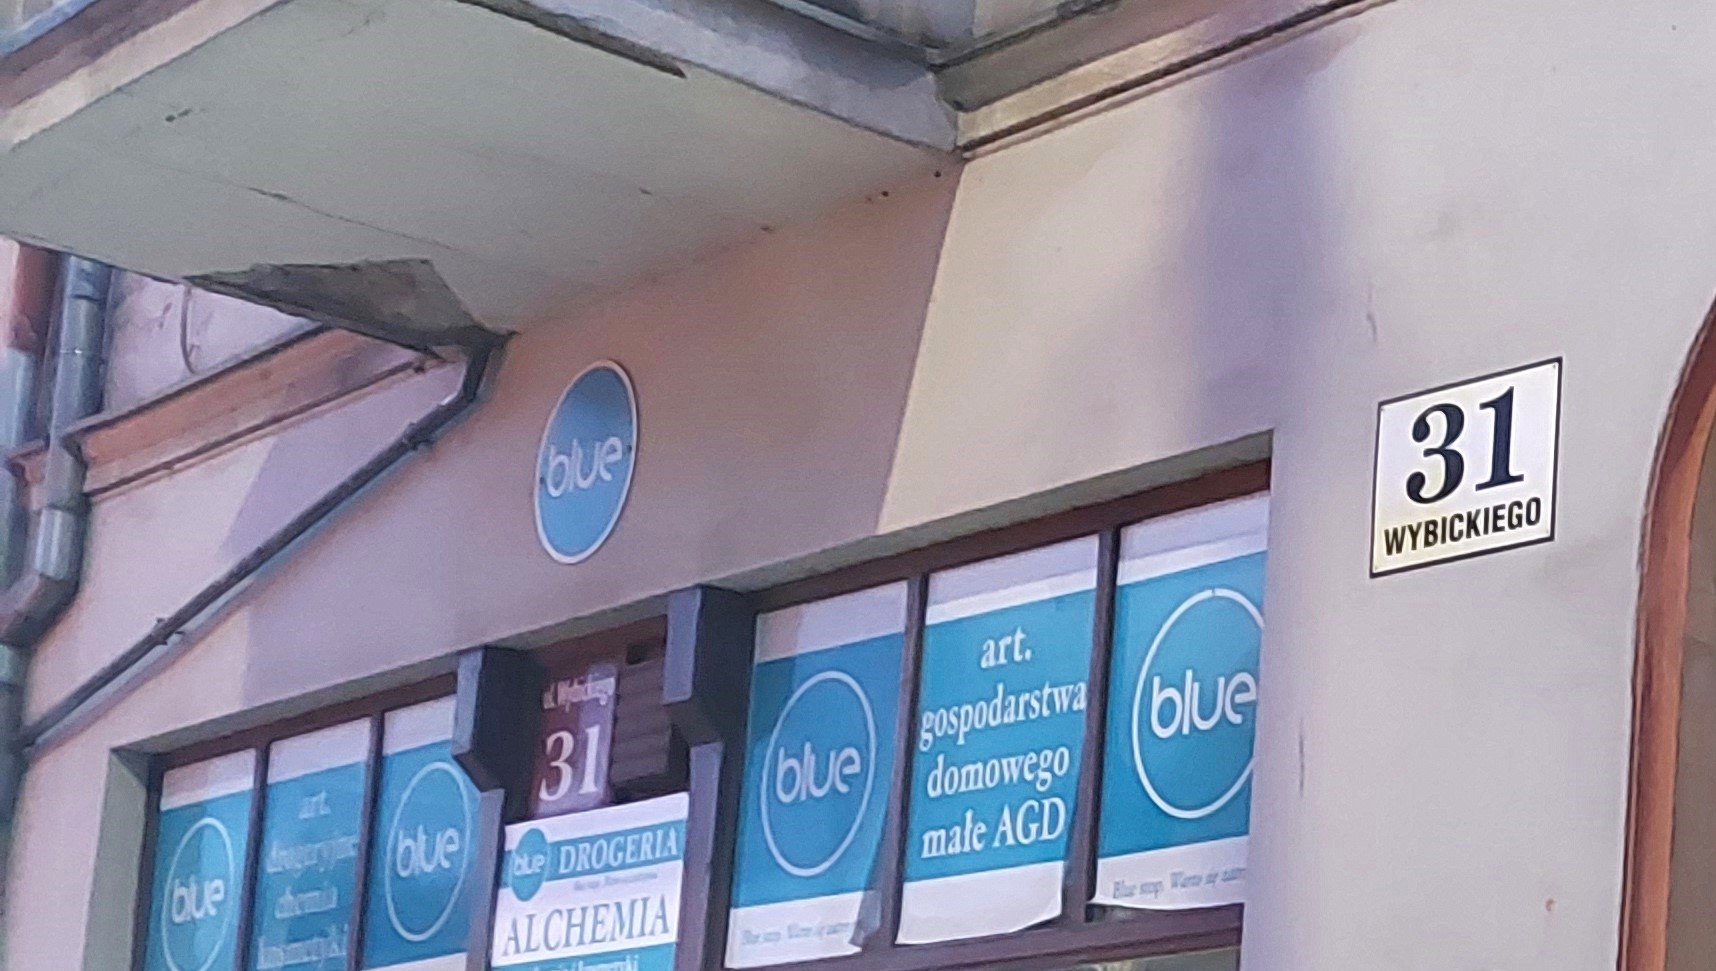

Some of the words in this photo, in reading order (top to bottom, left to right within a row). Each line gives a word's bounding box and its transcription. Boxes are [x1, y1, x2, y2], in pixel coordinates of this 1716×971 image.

[547, 436, 623, 498] blue
[1405, 385, 1525, 505] 31
[1383, 496, 1542, 556] WYBICKIEGO
[980, 625, 1033, 669] art.
[918, 680, 1088, 752] gospodarstwa
[1150, 668, 1257, 739] blue
[538, 724, 600, 802] 31
[775, 740, 861, 804] blue
[926, 746, 1071, 799] domowego
[396, 824, 460, 878] blue
[557, 826, 678, 875] DROGERIA
[920, 808, 988, 859] małe
[992, 796, 1067, 848] AGD
[171, 874, 225, 924] blue
[502, 892, 670, 957] ALCHEMIA
